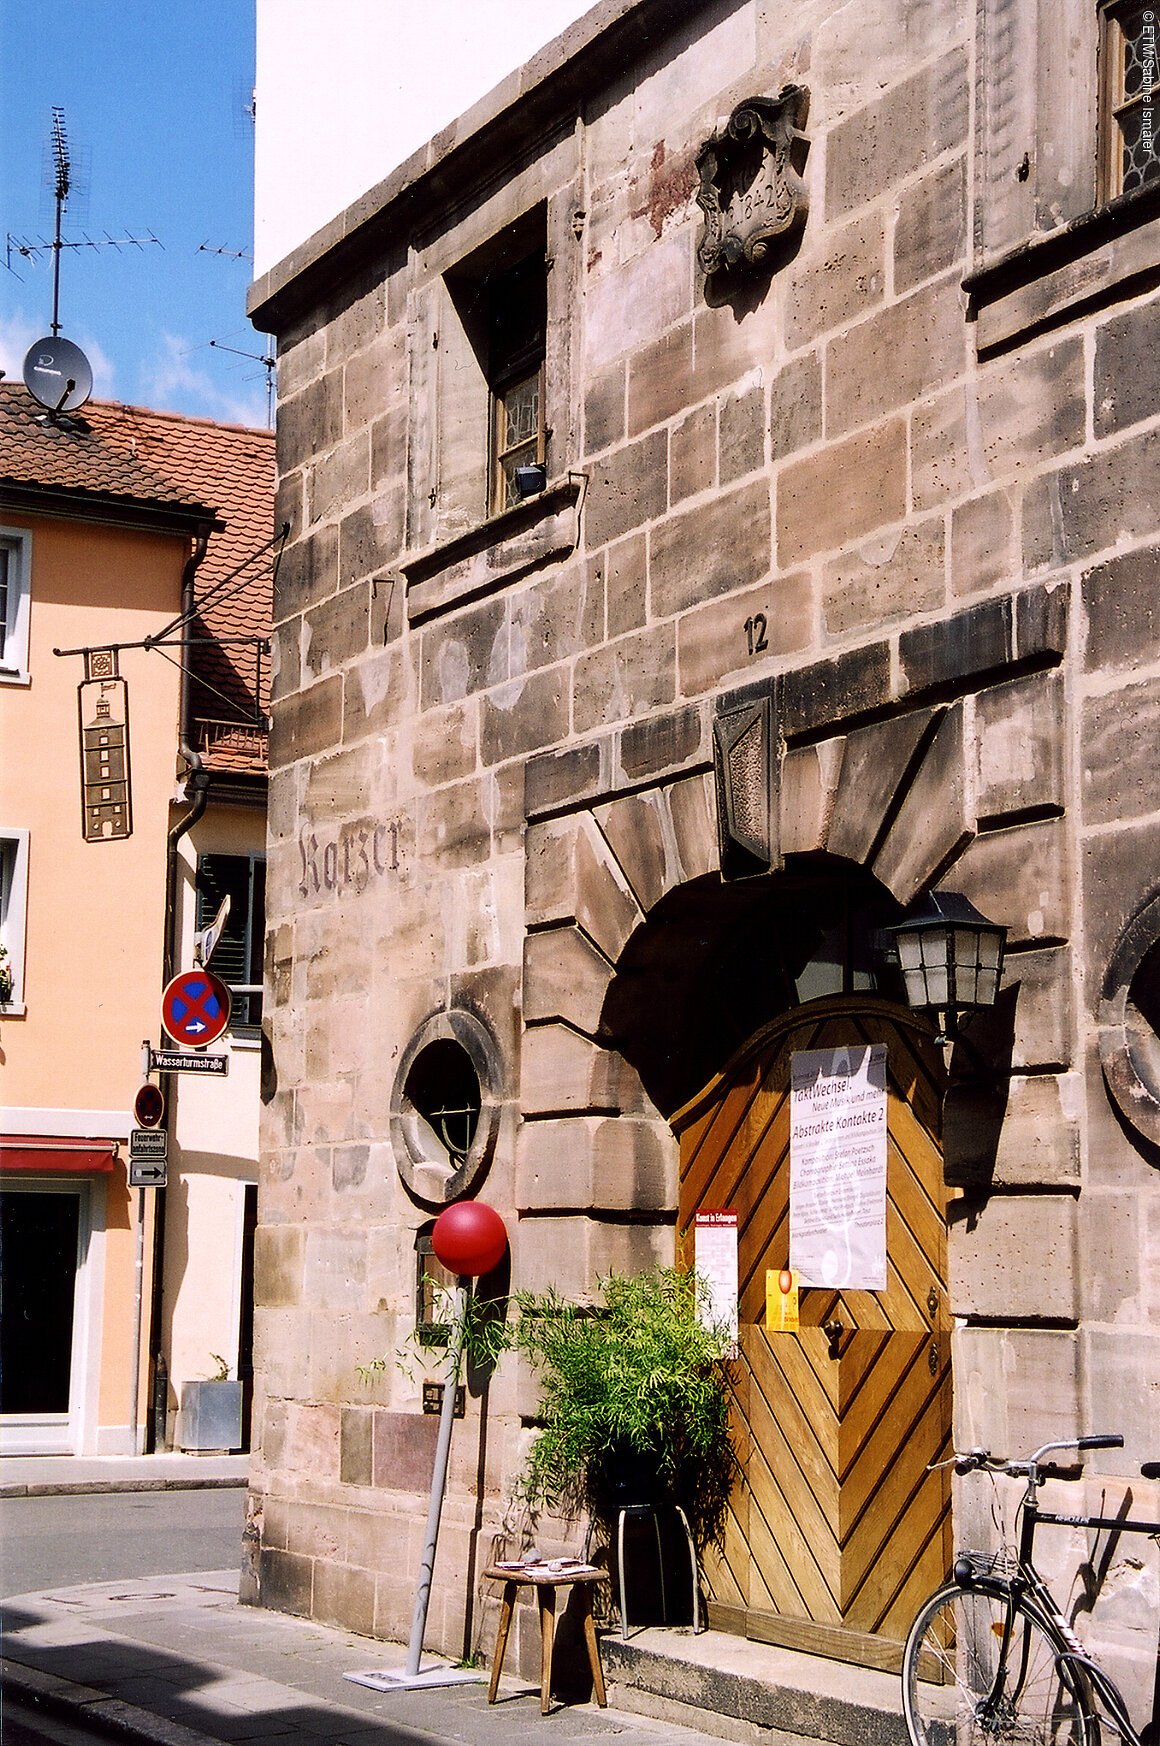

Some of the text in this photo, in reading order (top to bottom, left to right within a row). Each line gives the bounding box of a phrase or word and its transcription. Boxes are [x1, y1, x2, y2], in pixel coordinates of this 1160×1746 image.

[743, 612, 768, 656] 12
[155, 1054, 223, 1071] Wasserturmstraße
[794, 1076, 852, 1102] TaktWechsel.
[851, 1090, 865, 1104] und
[793, 1120, 834, 1139] Abstrakte
[836, 1110, 877, 1129] Kontakte
[878, 1107, 884, 1121] 2
